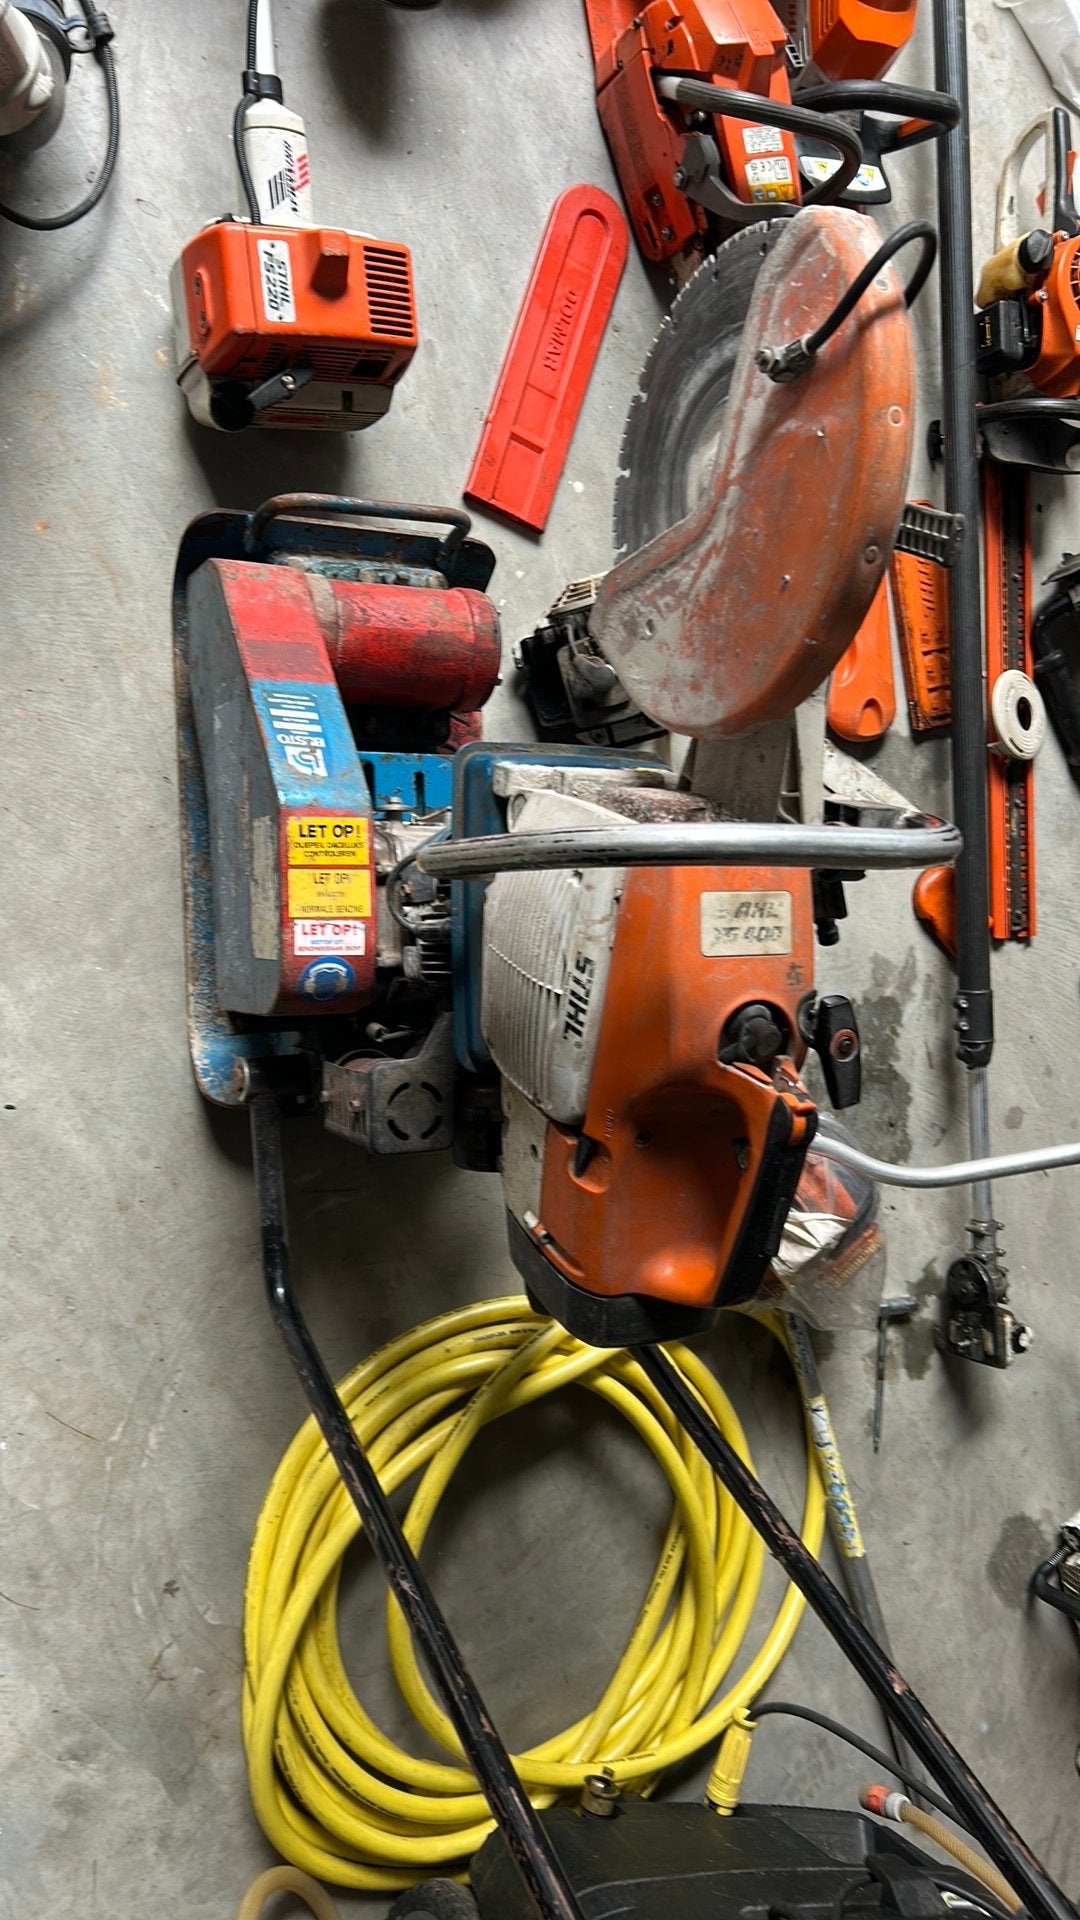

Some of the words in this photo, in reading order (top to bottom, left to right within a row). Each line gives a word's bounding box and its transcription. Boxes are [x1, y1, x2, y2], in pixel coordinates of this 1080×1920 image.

[275, 259, 291, 305] STIHL
[543, 291, 577, 372] DOLMAR
[299, 825, 327, 838] LET
[313, 873, 331, 885] LET
[302, 923, 328, 936] LET
[564, 952, 596, 1041] STIHL
